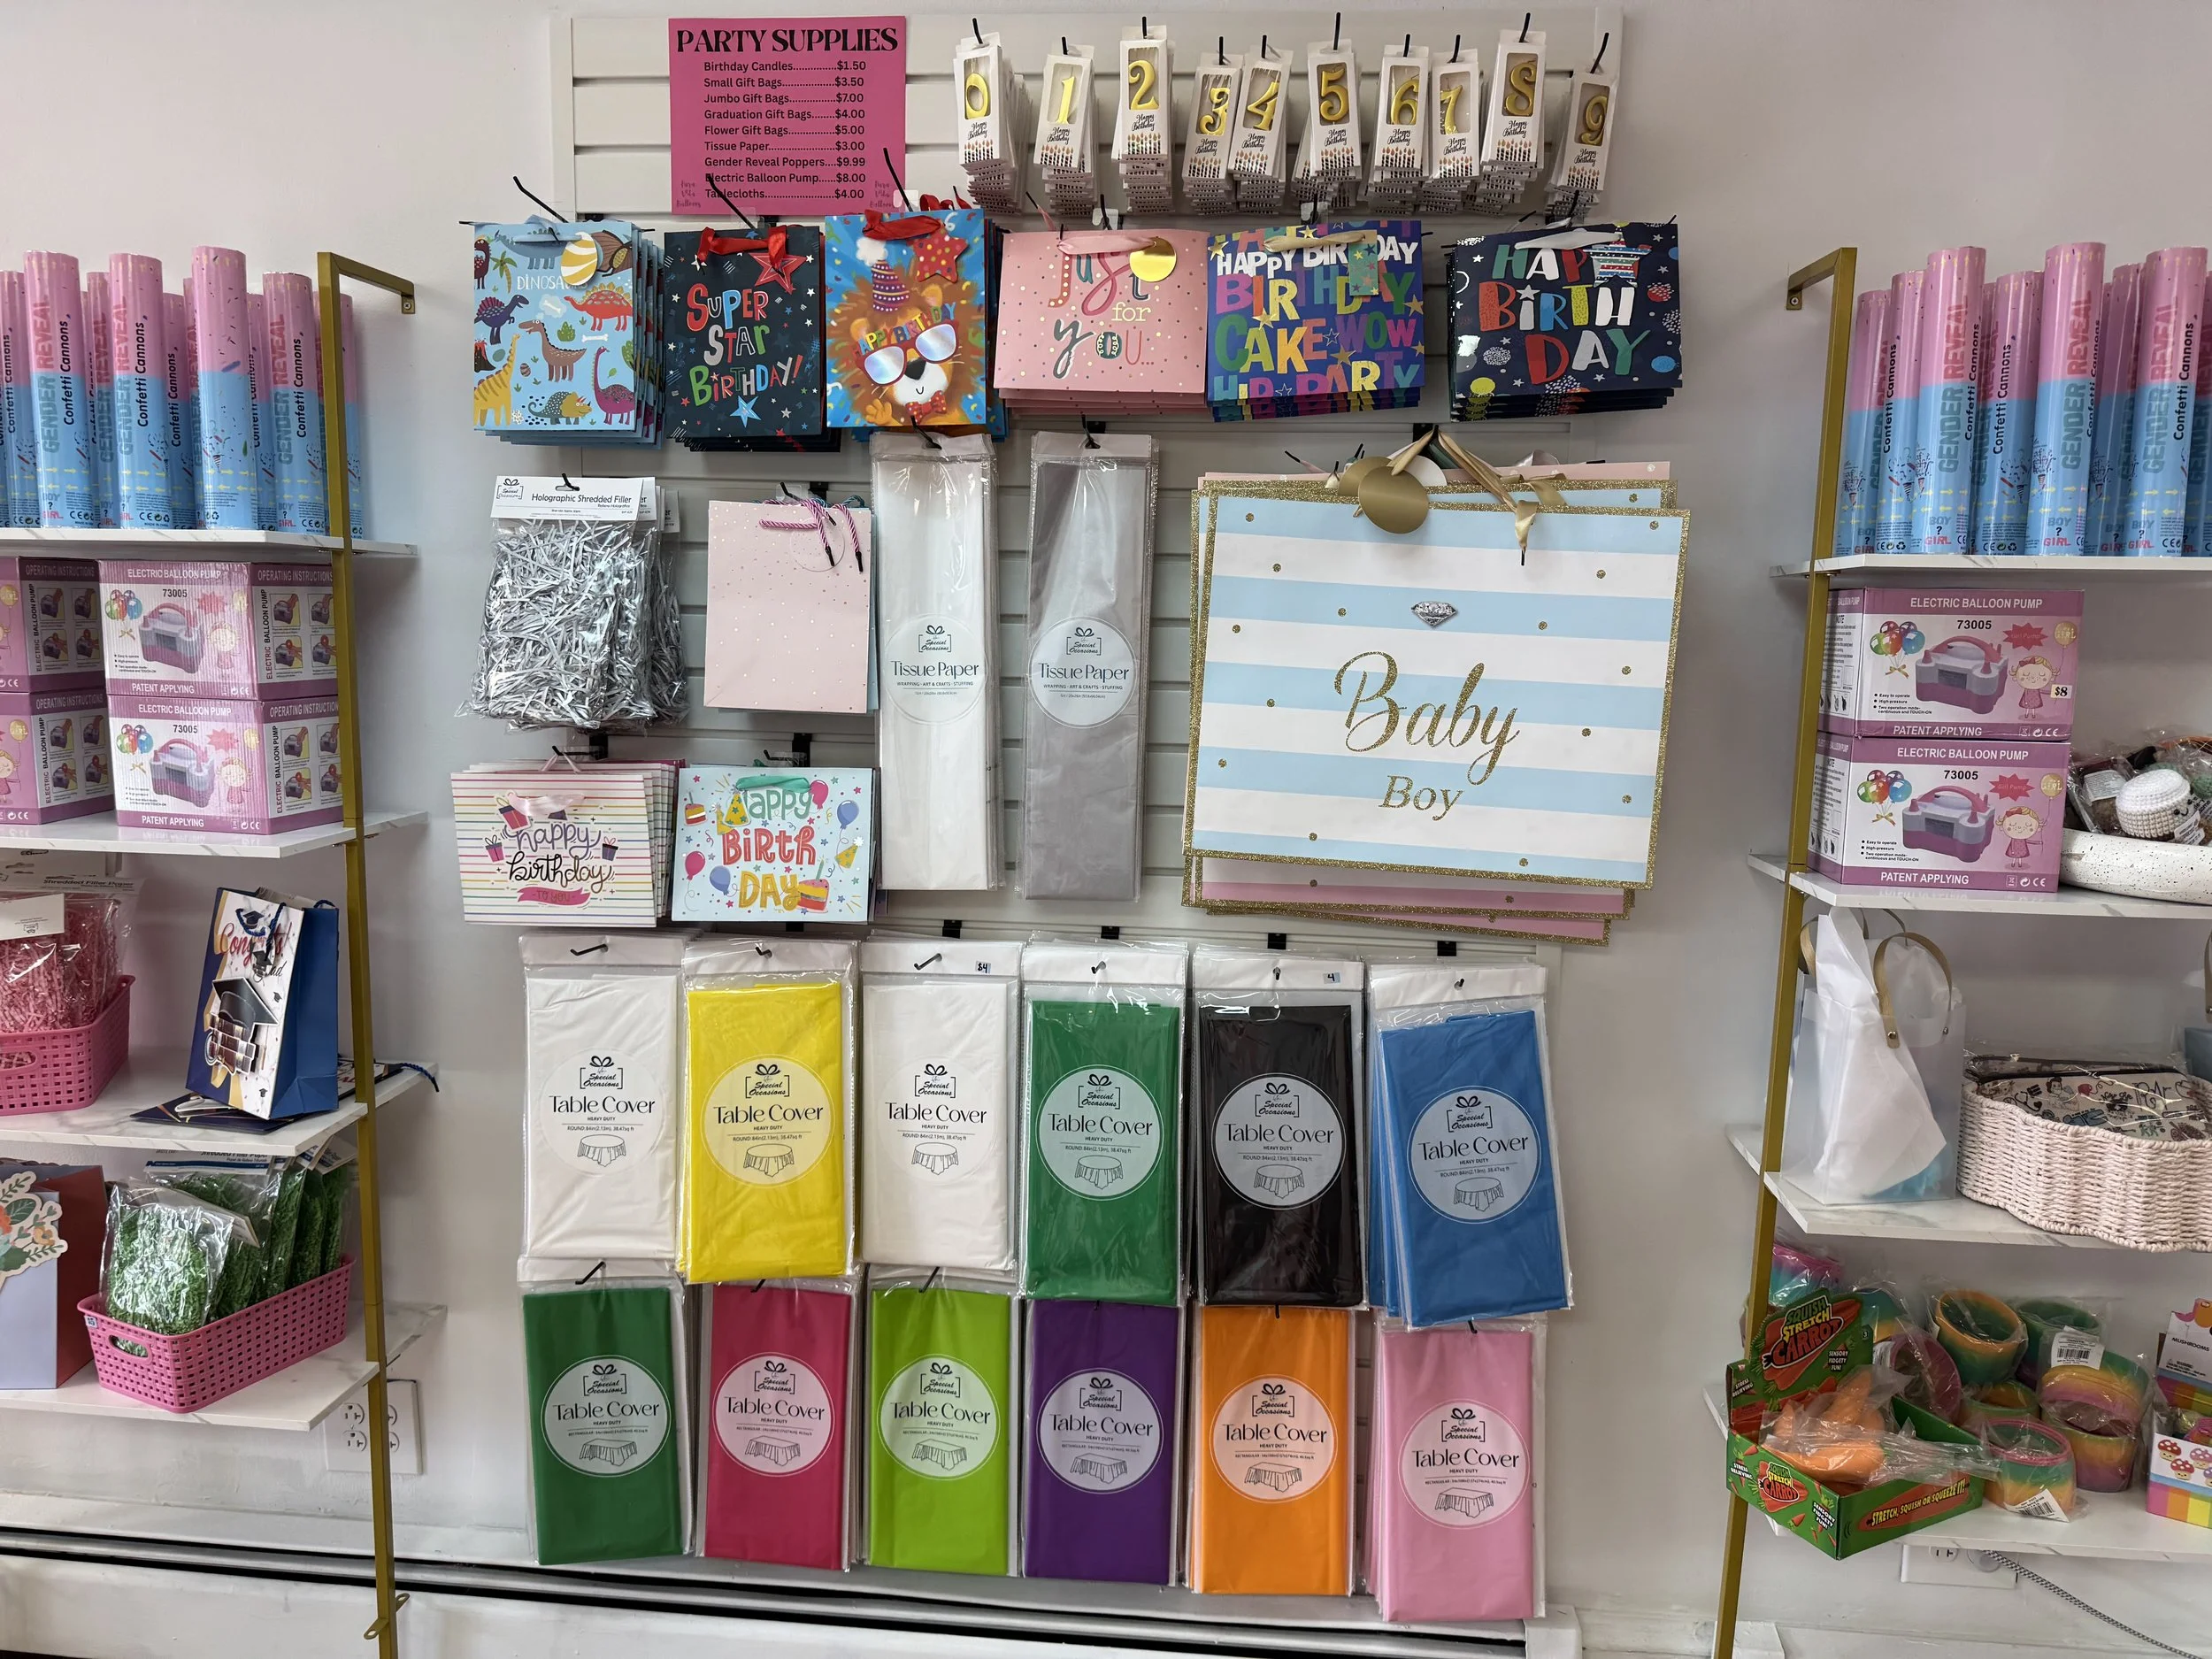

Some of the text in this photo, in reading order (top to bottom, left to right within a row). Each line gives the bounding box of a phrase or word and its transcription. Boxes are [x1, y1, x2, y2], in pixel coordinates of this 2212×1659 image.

[677, 28, 898, 52] PARTY SUPPLIES
[704, 62, 748, 72] Birthday
[735, 78, 755, 87] Gift
[1129, 60, 1159, 110] 2
[1319, 64, 1349, 121] 5
[704, 95, 740, 104] Jumbo
[743, 94, 762, 103] Gift
[1056, 76, 1075, 124] 1
[1247, 81, 1279, 131] 4
[1391, 79, 1418, 124] 6
[1440, 84, 1463, 134] 7
[704, 110, 762, 119] Graduation
[765, 110, 785, 119] Gift
[1199, 88, 1230, 135] 3
[704, 126, 739, 134] Flower
[742, 126, 761, 134] Gift
[704, 142, 736, 150] Tissue
[705, 157, 742, 167] Gender
[746, 157, 780, 166] Reveal
[747, 173, 783, 182] Balloon
[687, 282, 769, 331] SUPER
[1111, 302, 1151, 322] for
[1215, 311, 1416, 374] CAKE WOW
[1525, 329, 1651, 384] DAY
[59, 320, 74, 425] Confetti Cannons
[134, 321, 149, 427] Confetti Cannons
[2174, 322, 2193, 441] Confetti Cannons
[293, 338, 307, 438] Confetti Cannons
[1938, 296, 1969, 473] GENDER REVEAL
[532, 494, 575, 503] Holographic
[578, 494, 612, 503] Shredded
[128, 569, 163, 578] ELECTRIC
[200, 570, 221, 580] PUMP
[162, 589, 188, 598] 73005
[1910, 598, 2042, 609] ELECTRIC BALLOON PUMP
[1957, 620, 1992, 629] 73005
[891, 661, 979, 680] Tissue Paper
[1038, 663, 1129, 683] Tissue Paper
[2055, 687, 2067, 696] $8
[1334, 650, 1520, 785] Baby
[1893, 726, 1982, 736] PATENT APPLYING
[1897, 748, 2028, 760] ELECTRIC BALLOON PUMP
[1944, 771, 1978, 780] 73005
[1379, 774, 1464, 821] Boy
[507, 851, 612, 894] birthday
[1881, 872, 1969, 885] PATENT APPLYING
[978, 963, 987, 973] $4
[549, 1095, 655, 1113] Table Cover
[713, 1104, 823, 1124] Table Cover
[885, 1102, 987, 1123] Table Cover
[1048, 1113, 1152, 1135] Table Cover
[1224, 1124, 1333, 1143] Table Cover
[1418, 1136, 1528, 1161] Table Cover
[1786, 1296, 1827, 1325] SQUISH
[1783, 1308, 1831, 1343] STRETCH
[1772, 1320, 1839, 1365] CARROT
[2172, 1337, 2209, 1351] MUSHROOMS
[553, 1401, 659, 1420] Table Cover
[724, 1397, 825, 1420] Table Cover
[890, 1402, 990, 1425] Table Cover
[1049, 1414, 1153, 1436] Table Cover
[1223, 1423, 1327, 1443] Table Cover
[1412, 1448, 1519, 1468] Table Cover
[1871, 1507, 1899, 1526] STRETCH,
[1901, 1500, 1921, 1514] SQUISH
[1932, 1484, 1957, 1502] SQUEEZE
